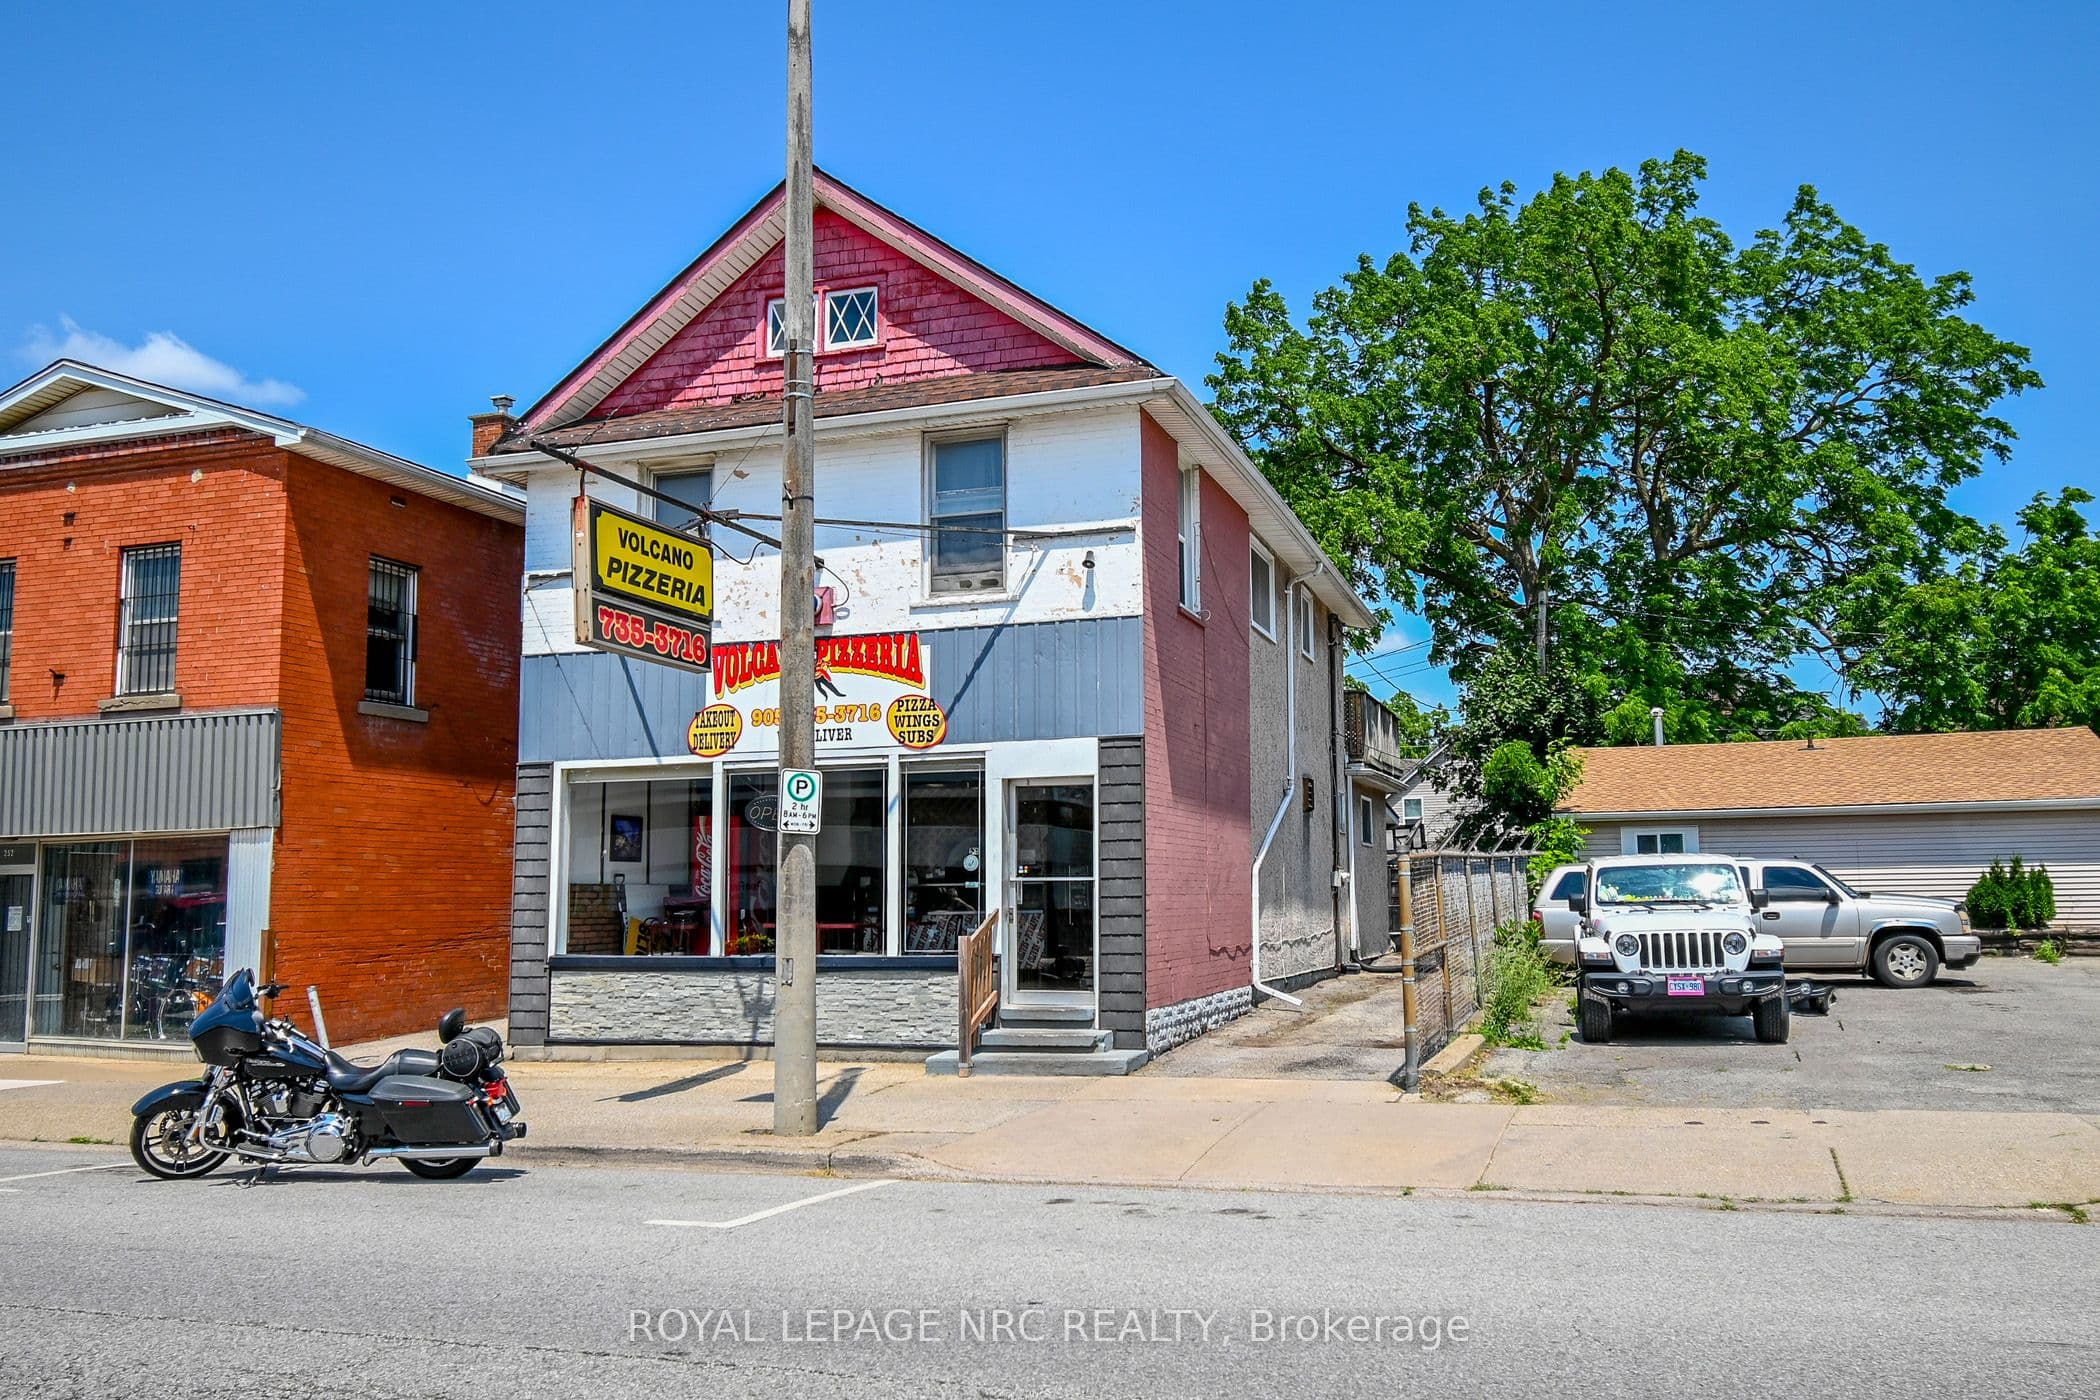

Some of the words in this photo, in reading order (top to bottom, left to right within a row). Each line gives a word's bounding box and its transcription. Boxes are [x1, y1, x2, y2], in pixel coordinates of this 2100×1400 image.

[618, 527, 694, 571] VOLCANO
[606, 556, 706, 607] PIZZERIA
[598, 605, 707, 664] 735-3716
[711, 642, 782, 699] VOLCA
[814, 632, 925, 690] PIZZERIA
[896, 698, 937, 712] PIZZA
[695, 709, 736, 729] TAKEOUT
[894, 714, 940, 728] WINGS
[692, 731, 736, 750] DELIVERY
[816, 727, 853, 742] LIVER
[898, 729, 934, 744] SUBS
[796, 779, 808, 795] P
[791, 802, 797, 810] 2
[800, 803, 808, 811] hr
